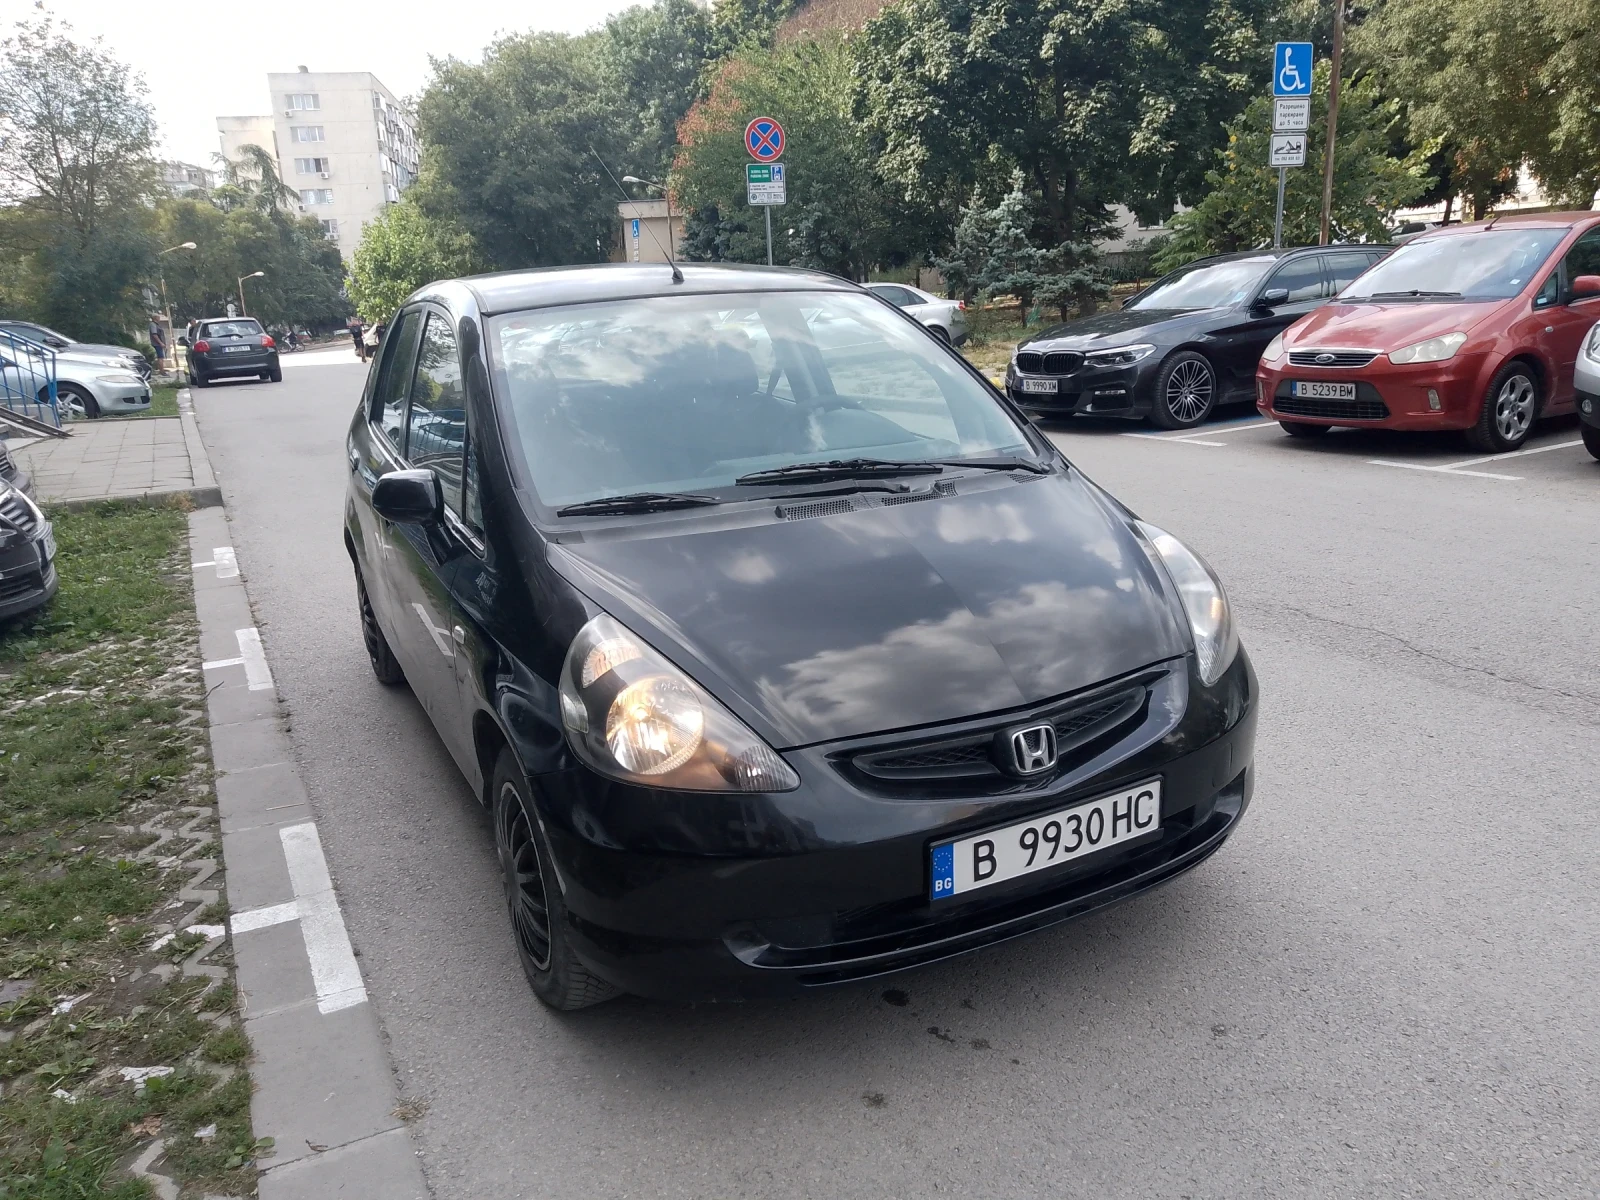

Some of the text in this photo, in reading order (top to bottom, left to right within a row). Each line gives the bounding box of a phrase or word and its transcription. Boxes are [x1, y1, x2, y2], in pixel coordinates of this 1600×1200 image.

[1025, 380, 1030, 390] B
[1032, 381, 1047, 391] 9990
[1301, 384, 1353, 398] B 5239 BM
[973, 790, 1154, 883] B 9930 HC
[935, 877, 952, 892] BG
